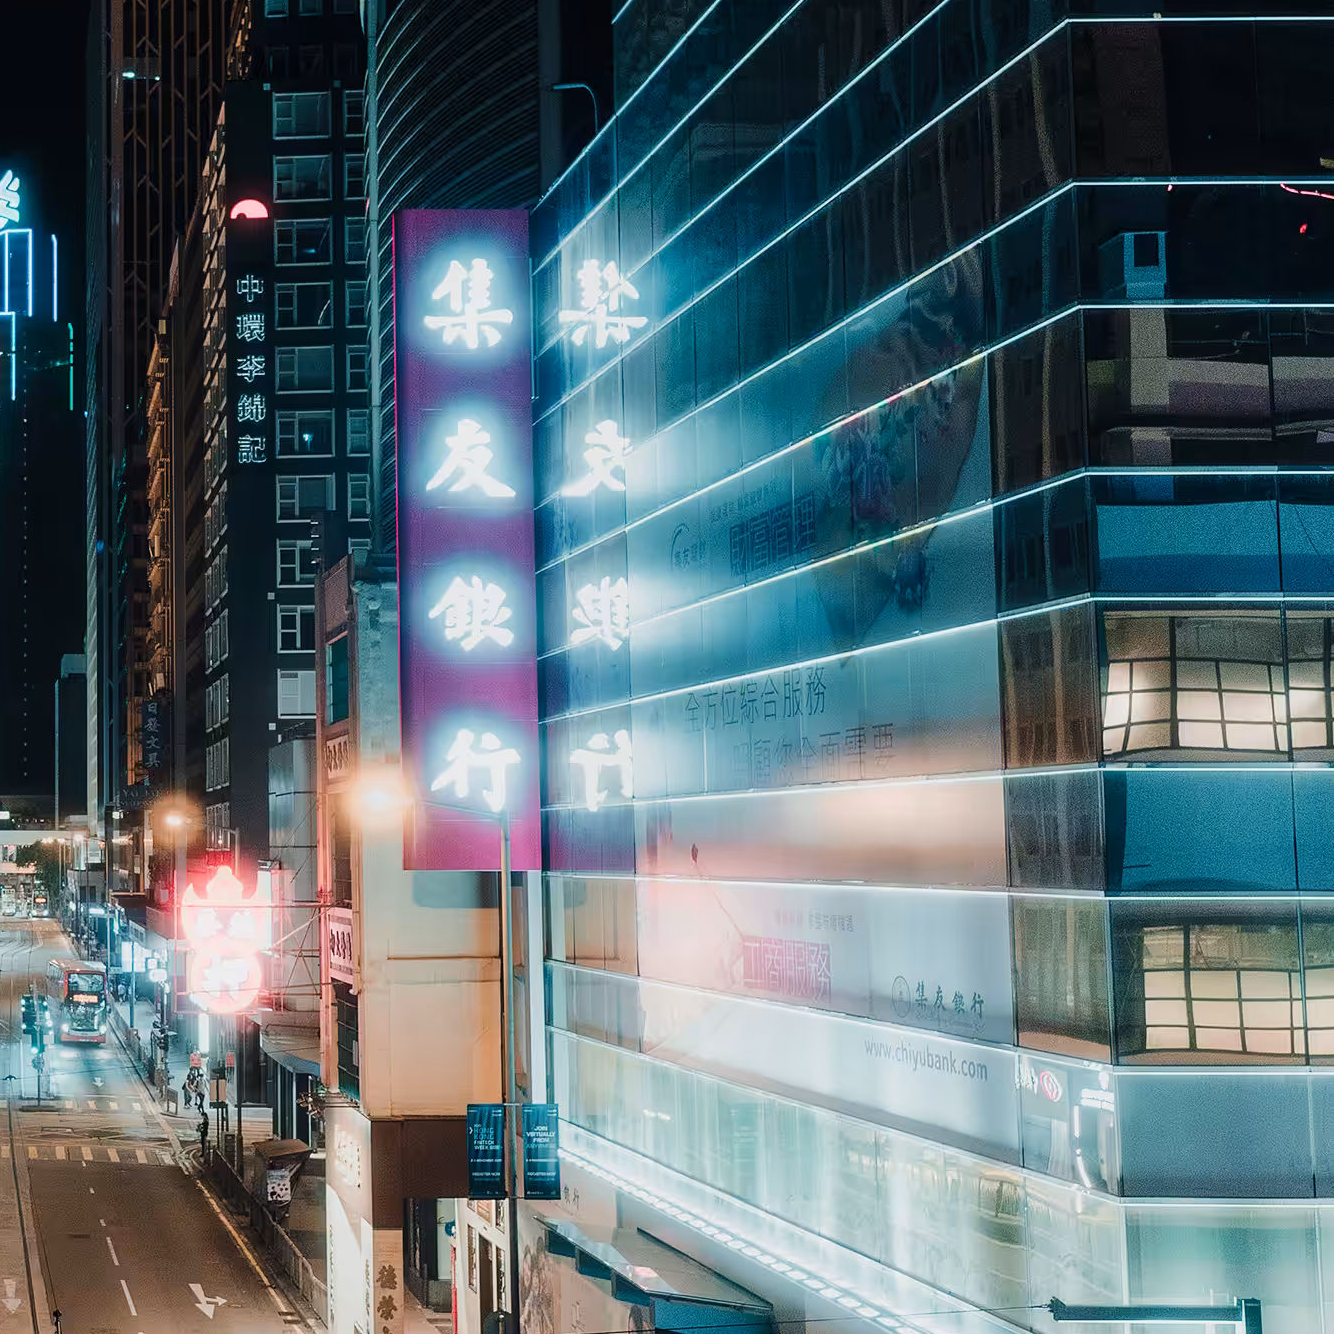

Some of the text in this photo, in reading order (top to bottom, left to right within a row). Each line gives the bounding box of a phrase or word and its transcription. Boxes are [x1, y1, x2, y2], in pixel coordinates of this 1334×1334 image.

[236, 274, 267, 463] 中環李錦記
[423, 258, 522, 812] 集友銀行
[730, 492, 816, 575] 財富管理
[685, 666, 828, 731] 全方位綜合服務
[144, 702, 163, 768] 日發文具
[744, 939, 832, 1004] 工商服務
[914, 980, 985, 1018] 集友銀行
[864, 1038, 988, 1081] www.chiyubank.com
